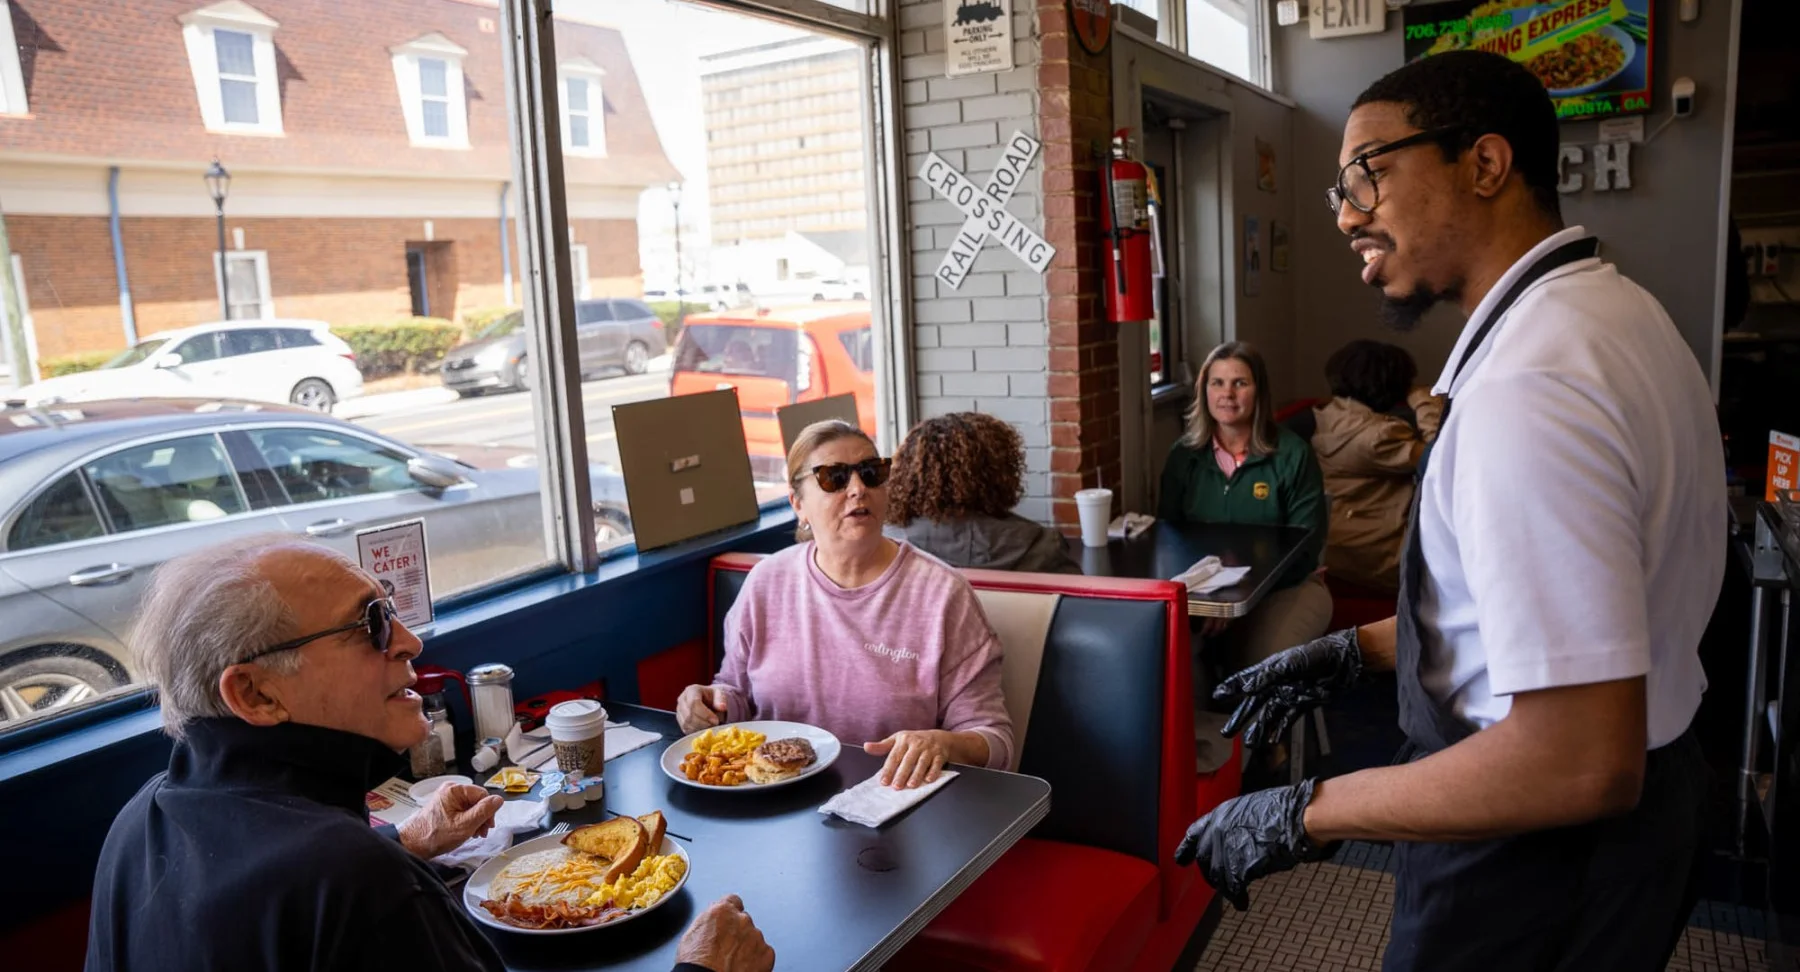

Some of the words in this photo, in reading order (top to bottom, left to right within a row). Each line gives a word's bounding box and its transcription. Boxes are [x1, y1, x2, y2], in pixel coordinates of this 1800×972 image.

[1323, 0, 1370, 29] EXIT
[962, 24, 993, 36] PARKING
[969, 34, 987, 43] ONLY
[927, 162, 1046, 264] CROSSING
[939, 231, 984, 285] RAIL
[987, 136, 1032, 203] ROAD
[1774, 450, 1792, 465] PICK
[1777, 464, 1788, 476] UP
[1772, 475, 1791, 489] HERE
[371, 545, 390, 559] WE
[373, 555, 410, 574] CATER
